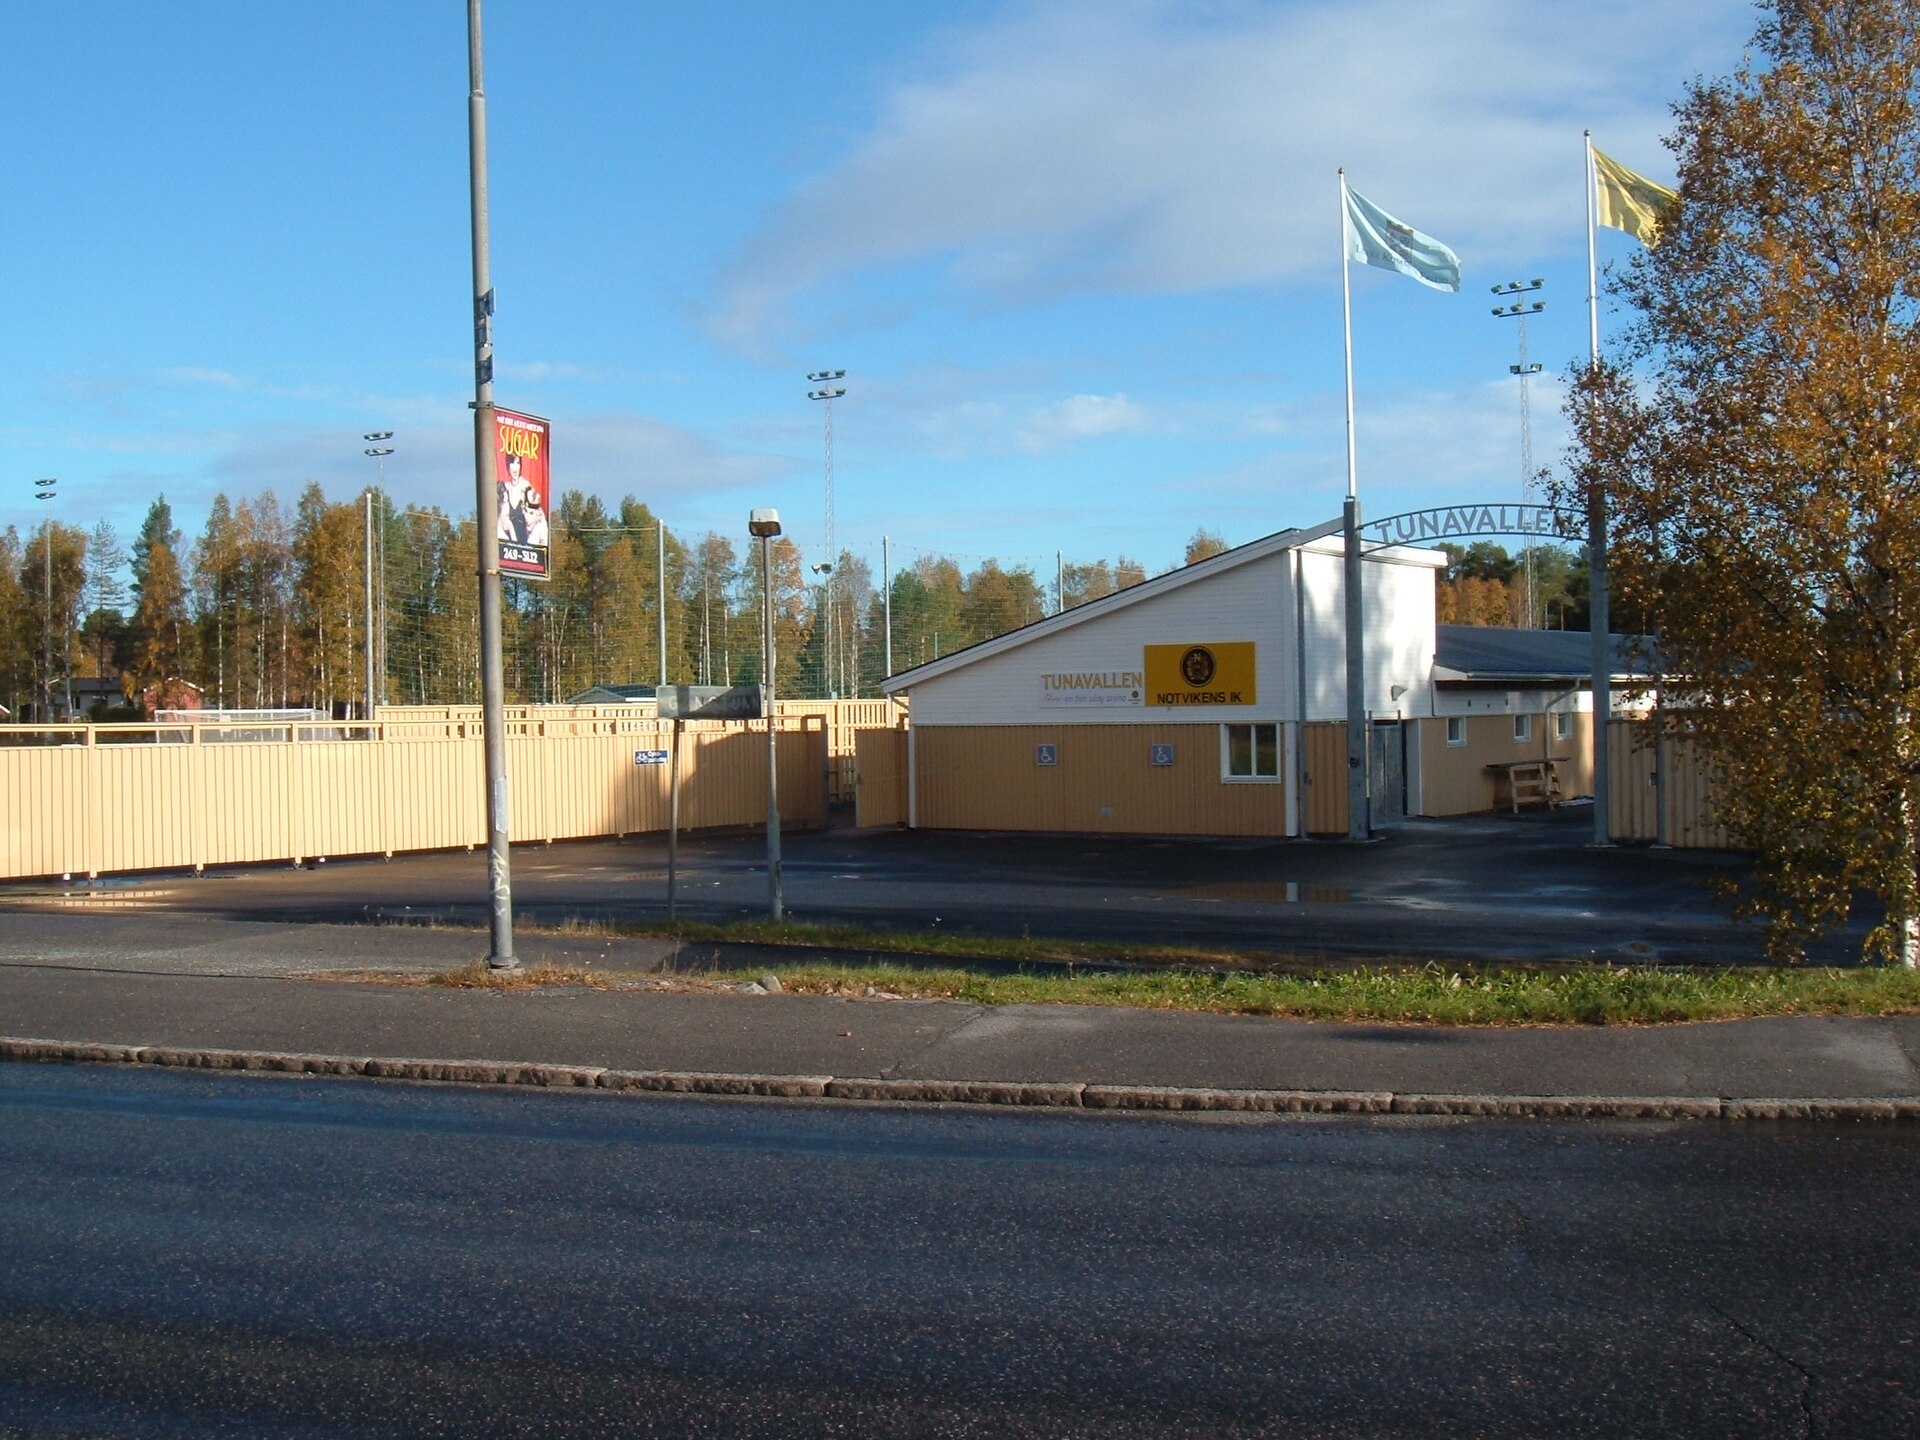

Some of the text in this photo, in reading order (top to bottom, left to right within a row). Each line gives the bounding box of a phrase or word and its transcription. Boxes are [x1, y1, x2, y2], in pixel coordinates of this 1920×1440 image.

[499, 425, 539, 460] SUGAR
[1041, 672, 1143, 690] TUNAVALLEN
[1157, 692, 1242, 704] NOTVIKENS IK
